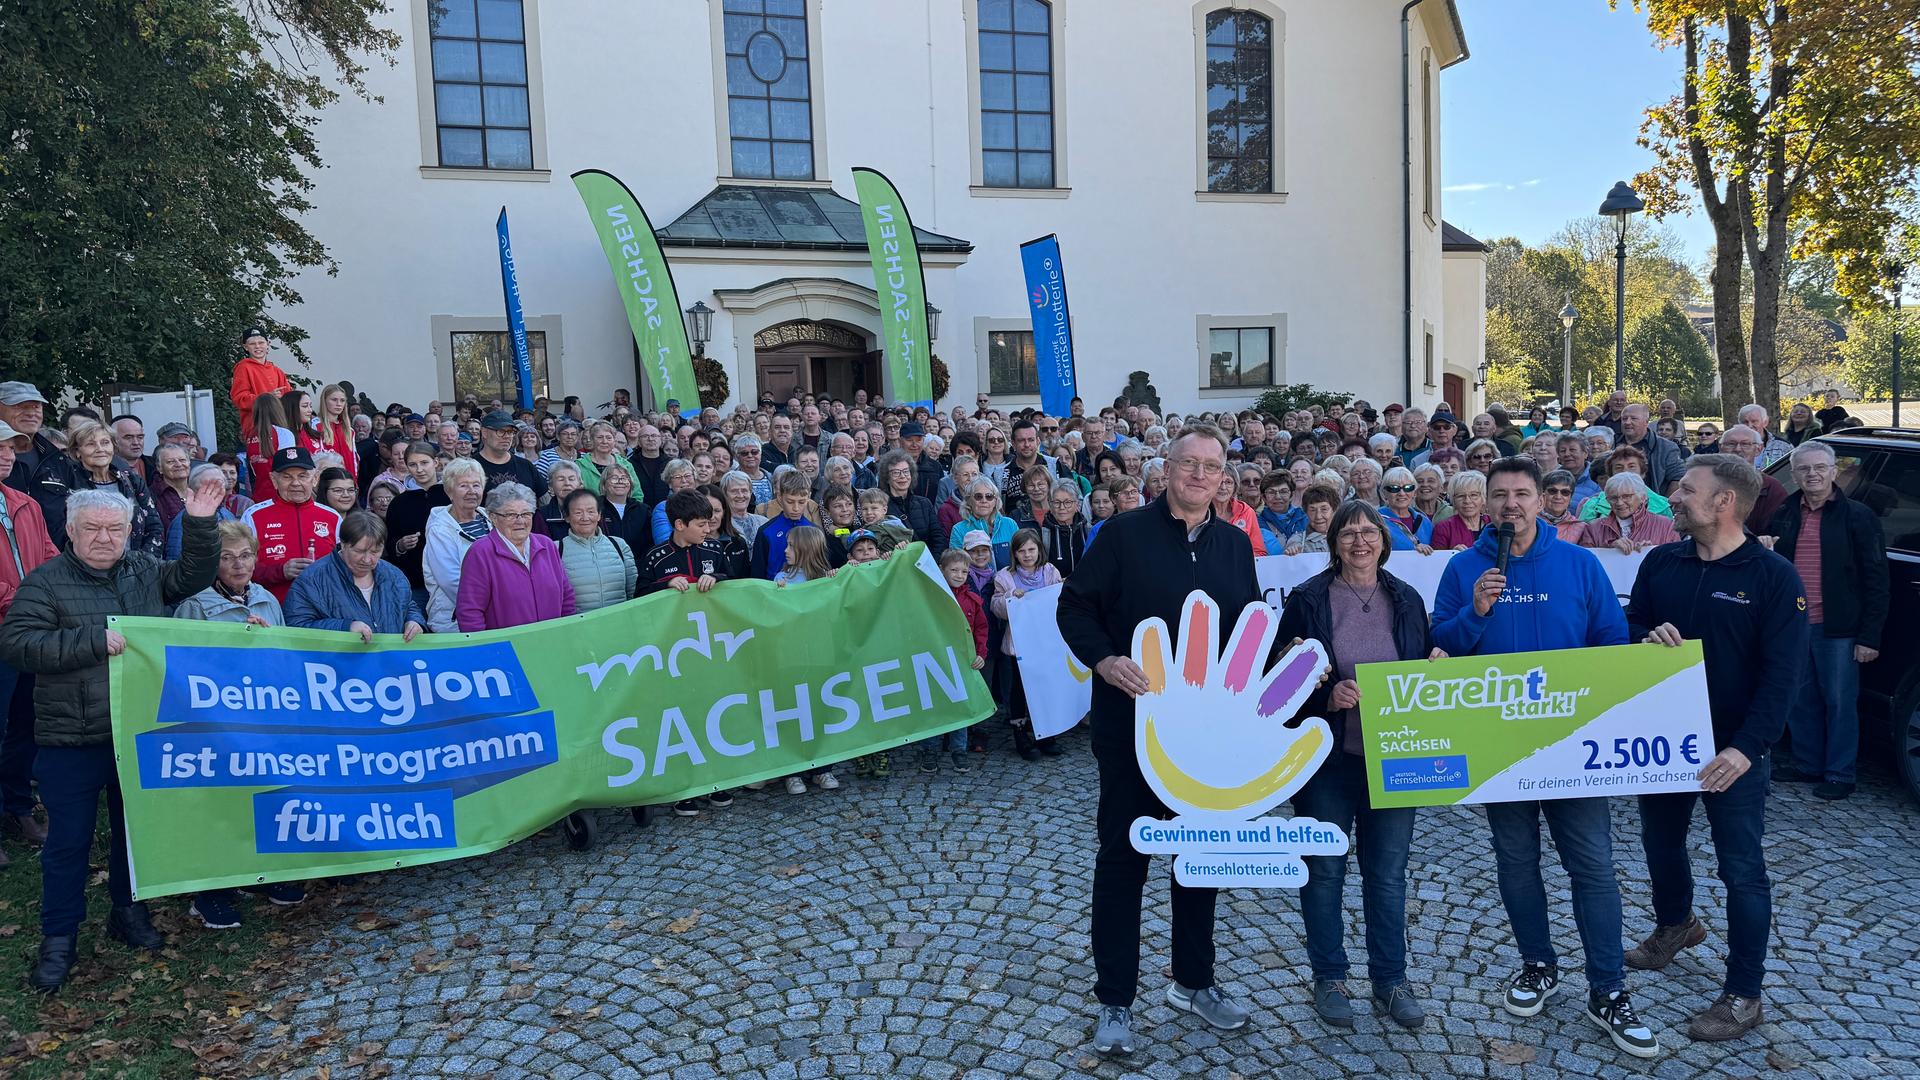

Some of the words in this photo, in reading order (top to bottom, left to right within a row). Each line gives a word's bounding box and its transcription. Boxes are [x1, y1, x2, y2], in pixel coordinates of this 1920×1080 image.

[1048, 269, 1072, 387] Fernsehlotterie
[514, 328, 531, 372] DEUTSCHE
[1052, 341, 1063, 377] DEUTSCHE
[576, 611, 755, 692] mdr
[187, 676, 301, 711] Deine
[303, 659, 512, 726] Region
[601, 645, 969, 788] SACHSEN
[1378, 725, 1418, 739] mdr
[160, 742, 216, 779] ist
[228, 751, 330, 777] unser
[337, 730, 543, 783] Programm
[1380, 738, 1451, 753] SACHSEN
[1582, 735, 1671, 770] 2.500
[1680, 734, 1701, 765] €
[1390, 772, 1455, 785] Fernsehlotterie
[1518, 778, 1537, 790] für
[1539, 776, 1581, 789] deinen
[1584, 774, 1623, 787] Verein
[1627, 773, 1639, 785] in
[274, 799, 346, 842] für
[355, 801, 443, 841] dich
[1139, 825, 1231, 843] Gewinnen
[1236, 825, 1271, 843] und
[1276, 825, 1341, 844] helfen.
[1184, 861, 1300, 877] fernsehlotterie.de
